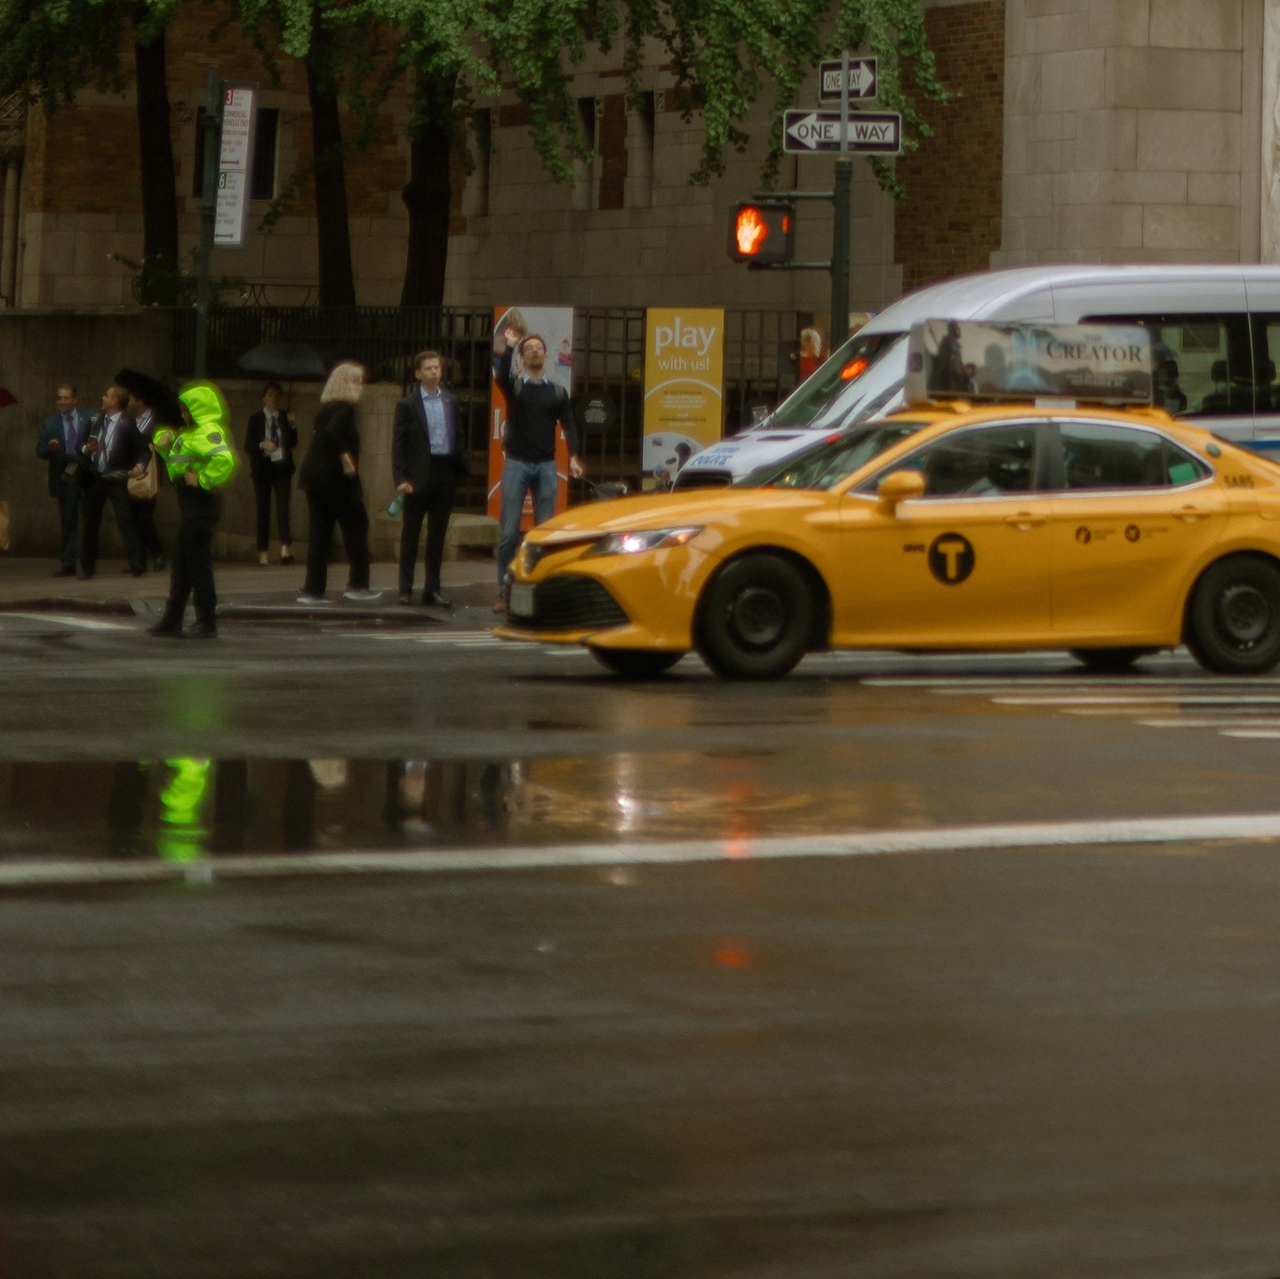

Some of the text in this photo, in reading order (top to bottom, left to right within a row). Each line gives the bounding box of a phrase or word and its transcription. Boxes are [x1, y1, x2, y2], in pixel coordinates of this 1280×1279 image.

[825, 72, 841, 90] ONE
[226, 89, 232, 106] 3
[797, 124, 890, 140] ONE WAY
[655, 316, 717, 357] play
[1046, 341, 1143, 363] CREATOR
[658, 356, 710, 371] with us!
